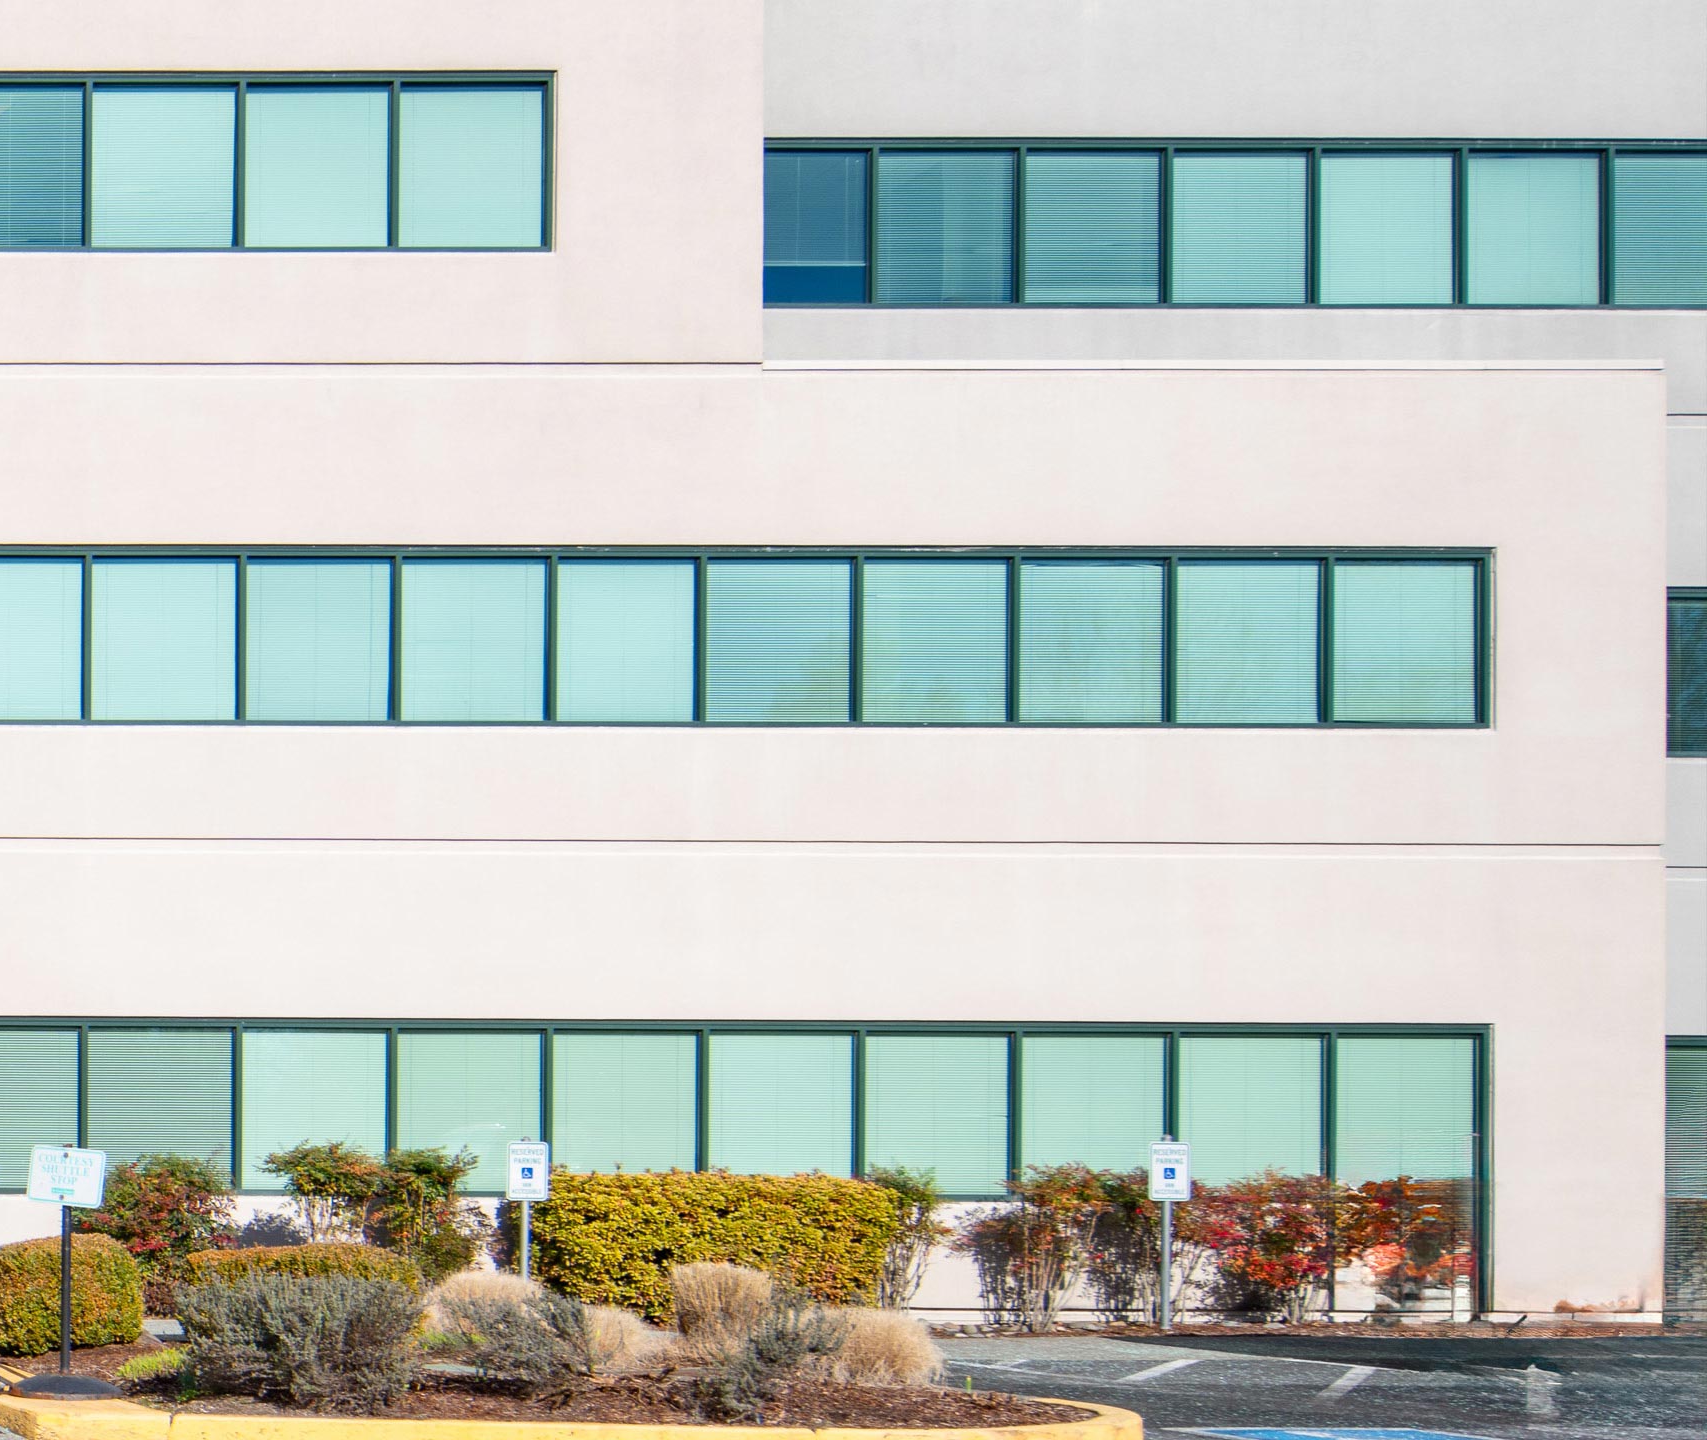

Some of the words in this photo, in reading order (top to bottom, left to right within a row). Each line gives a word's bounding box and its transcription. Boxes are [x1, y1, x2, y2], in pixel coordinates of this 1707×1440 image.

[38, 1153, 94, 1167] COURTESY
[41, 1164, 90, 1177] SHUTTLE
[51, 1174, 78, 1186] STOP
